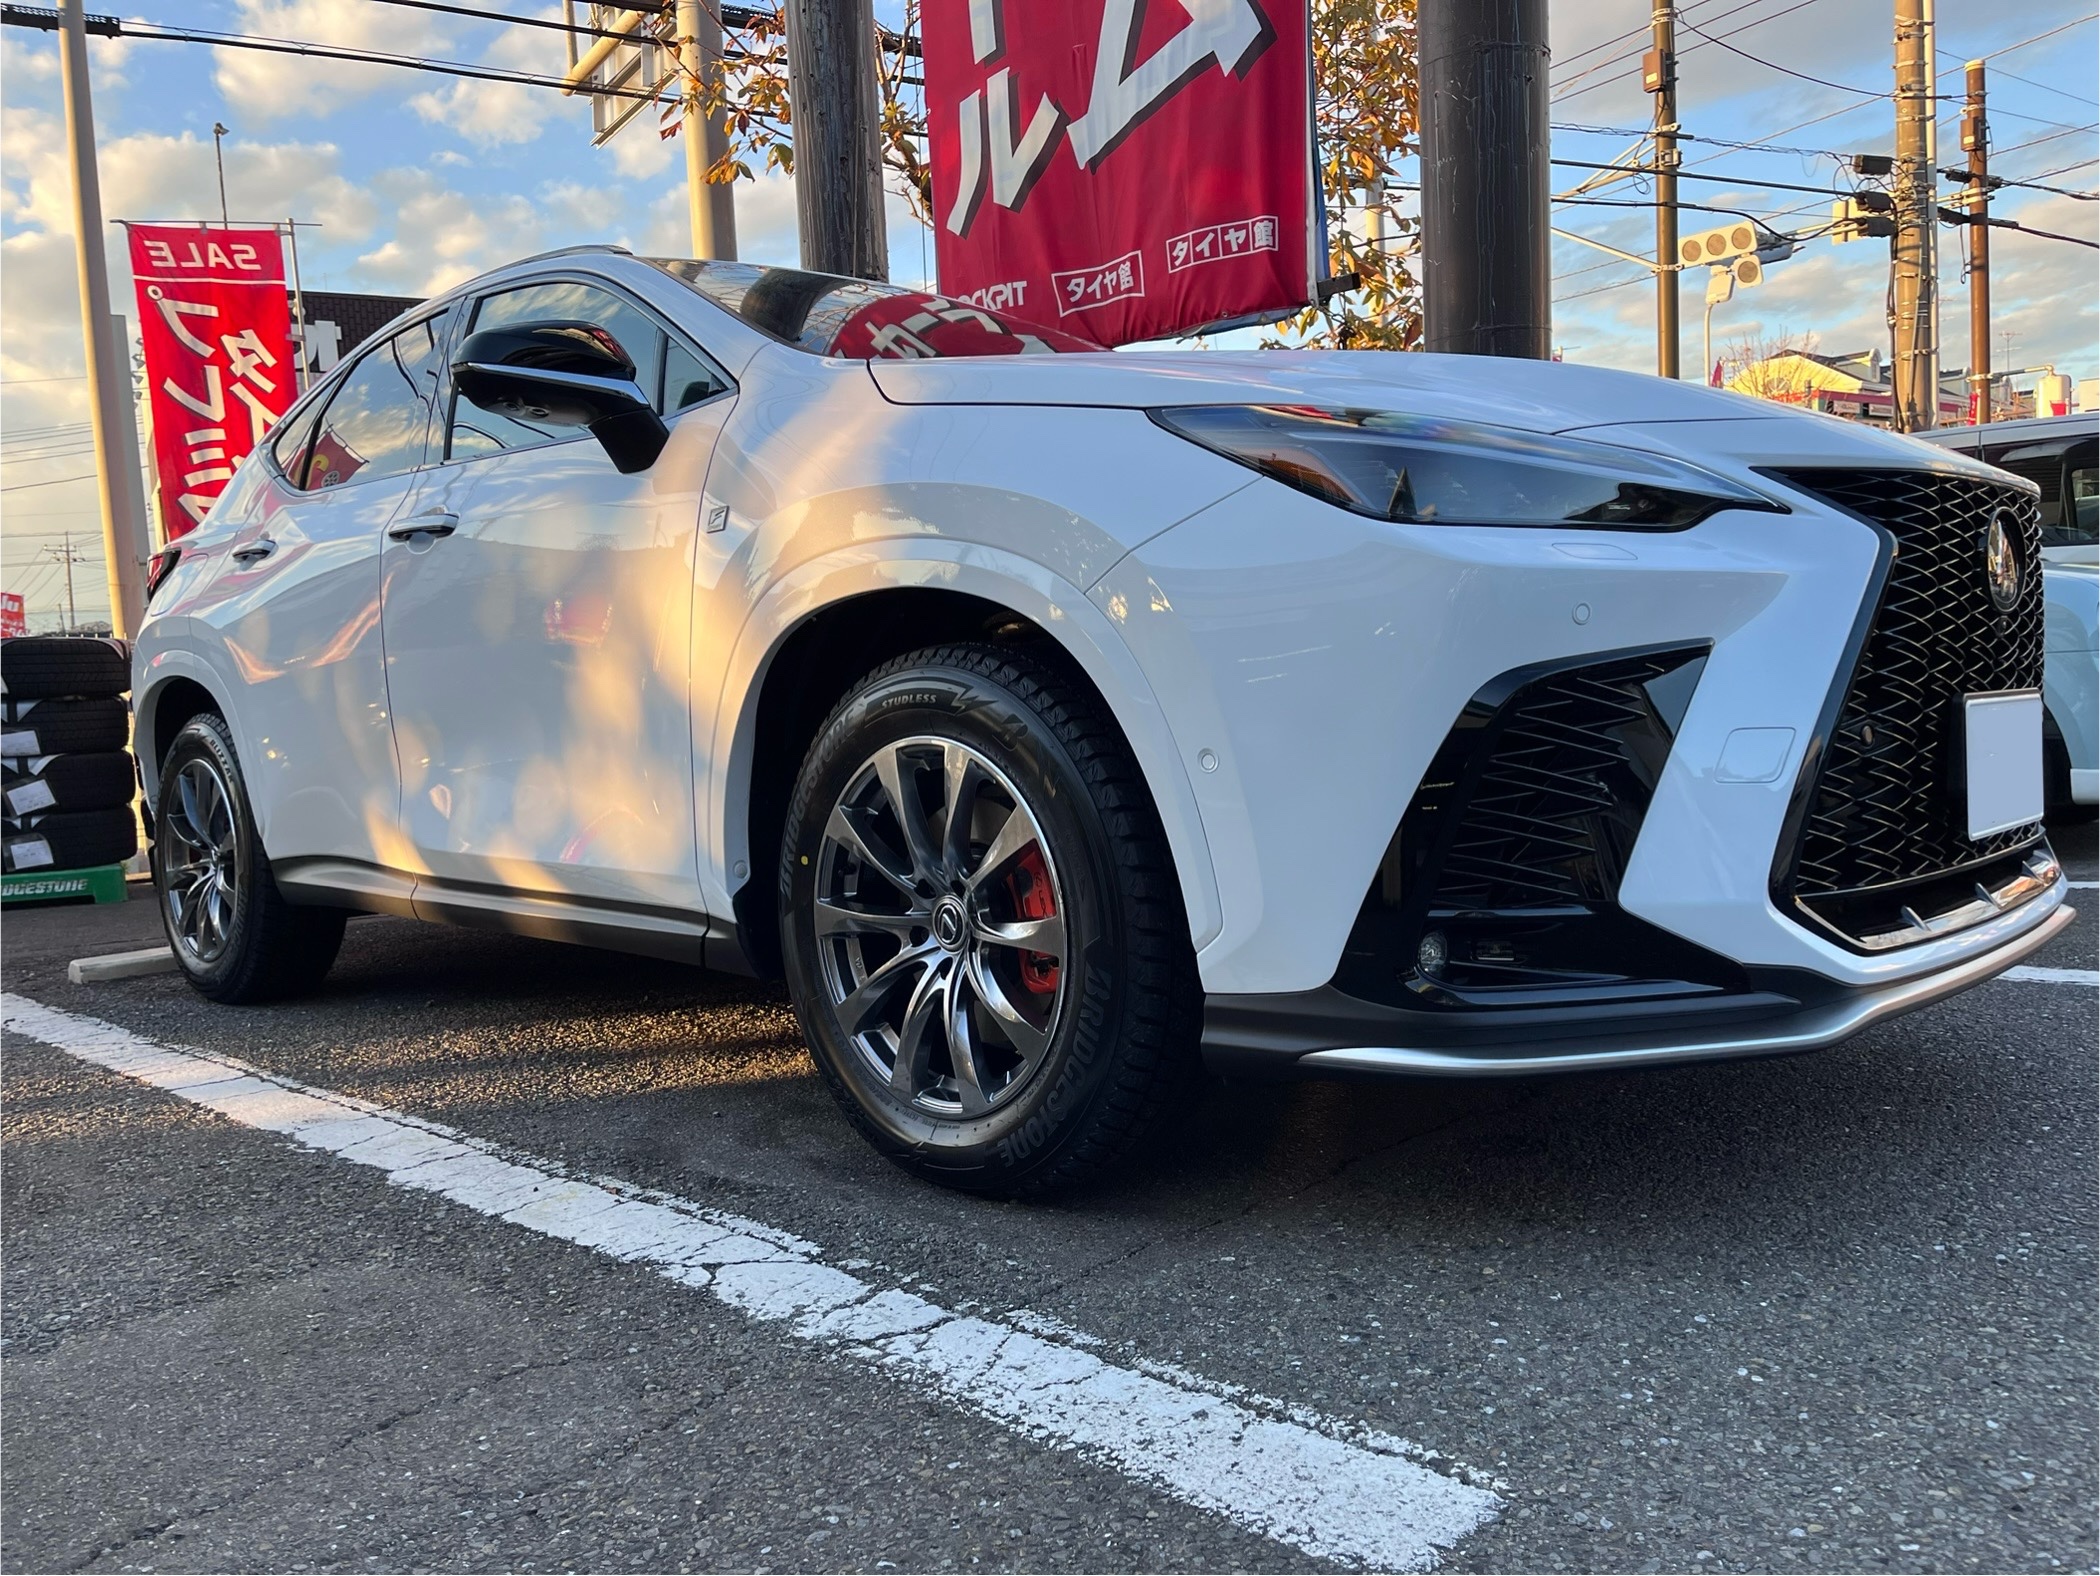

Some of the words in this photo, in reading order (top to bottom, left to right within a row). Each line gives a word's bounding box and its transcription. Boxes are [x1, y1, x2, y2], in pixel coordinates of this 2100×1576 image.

[1171, 219, 1274, 266] タイヤ館
[1065, 261, 1134, 303] タイヤ館
[881, 693, 938, 709] STUDLESS
[998, 960, 1112, 1169] BRIDGESTONE
